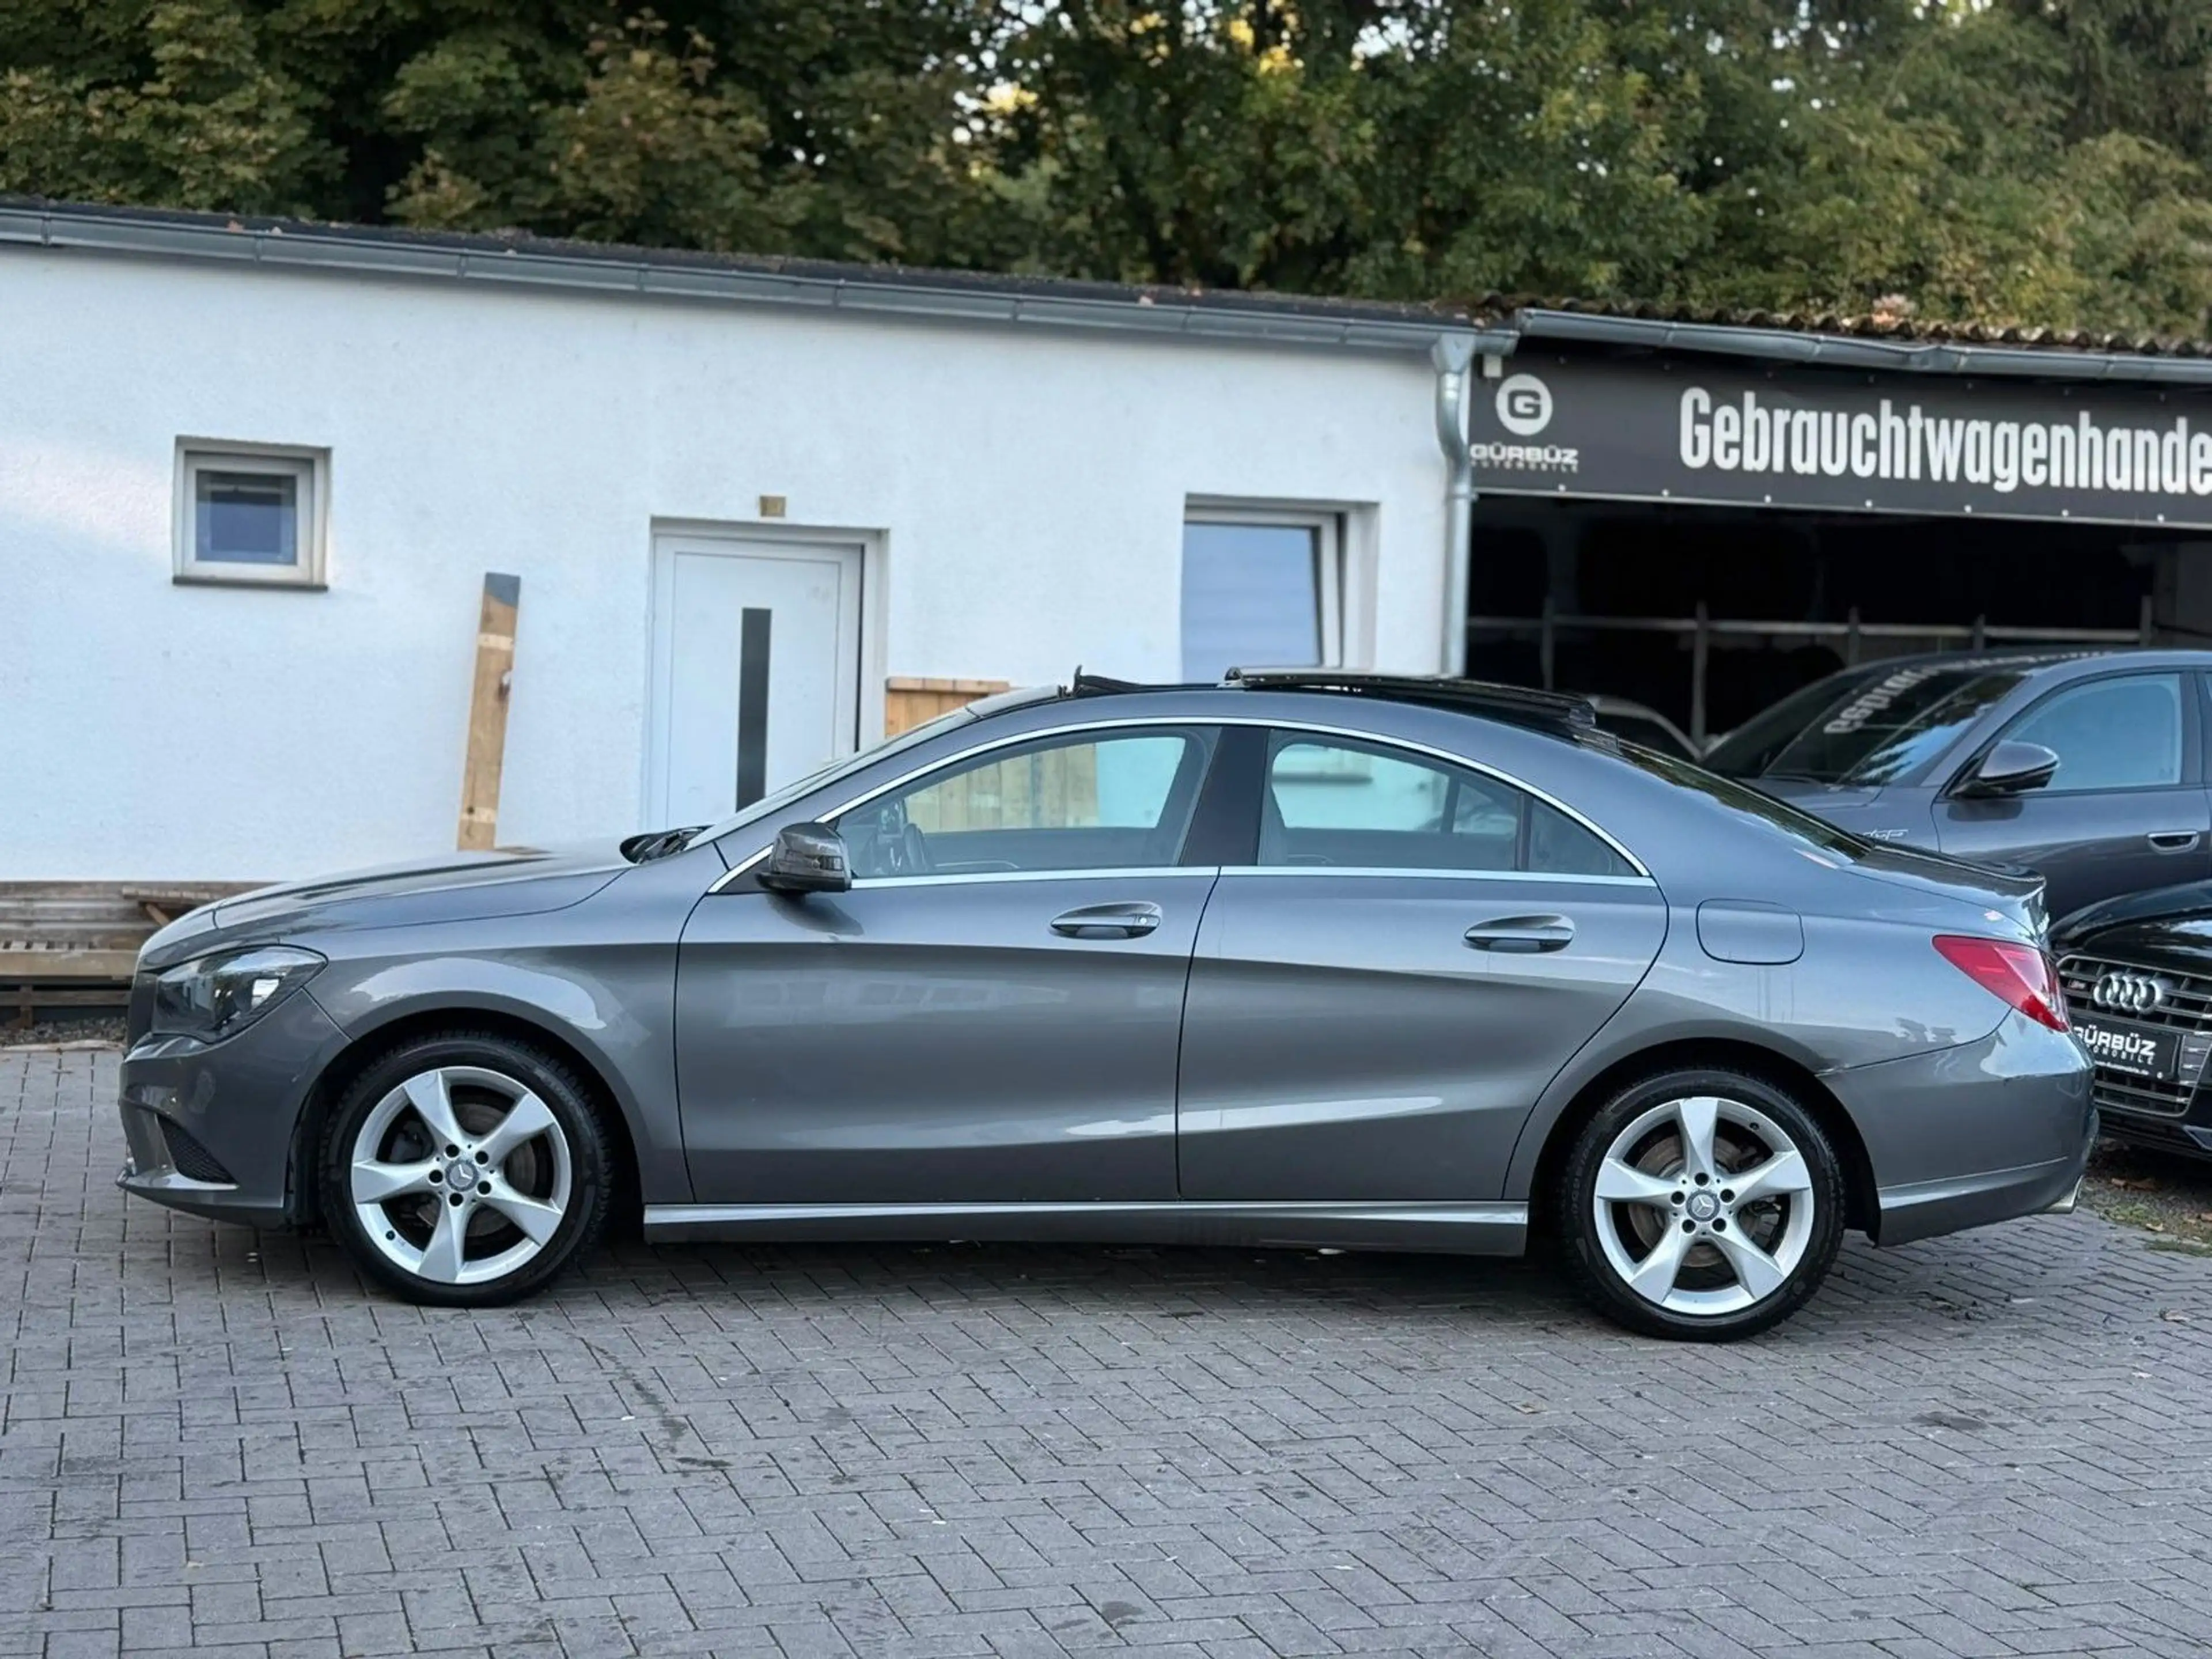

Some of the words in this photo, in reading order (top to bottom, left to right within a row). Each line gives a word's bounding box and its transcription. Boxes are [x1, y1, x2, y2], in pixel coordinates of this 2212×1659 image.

[1507, 389, 1541, 420] G
[1469, 442, 1579, 464] GÜRBÜZ
[1679, 387, 2212, 497] Gebrauchtwagenhande
